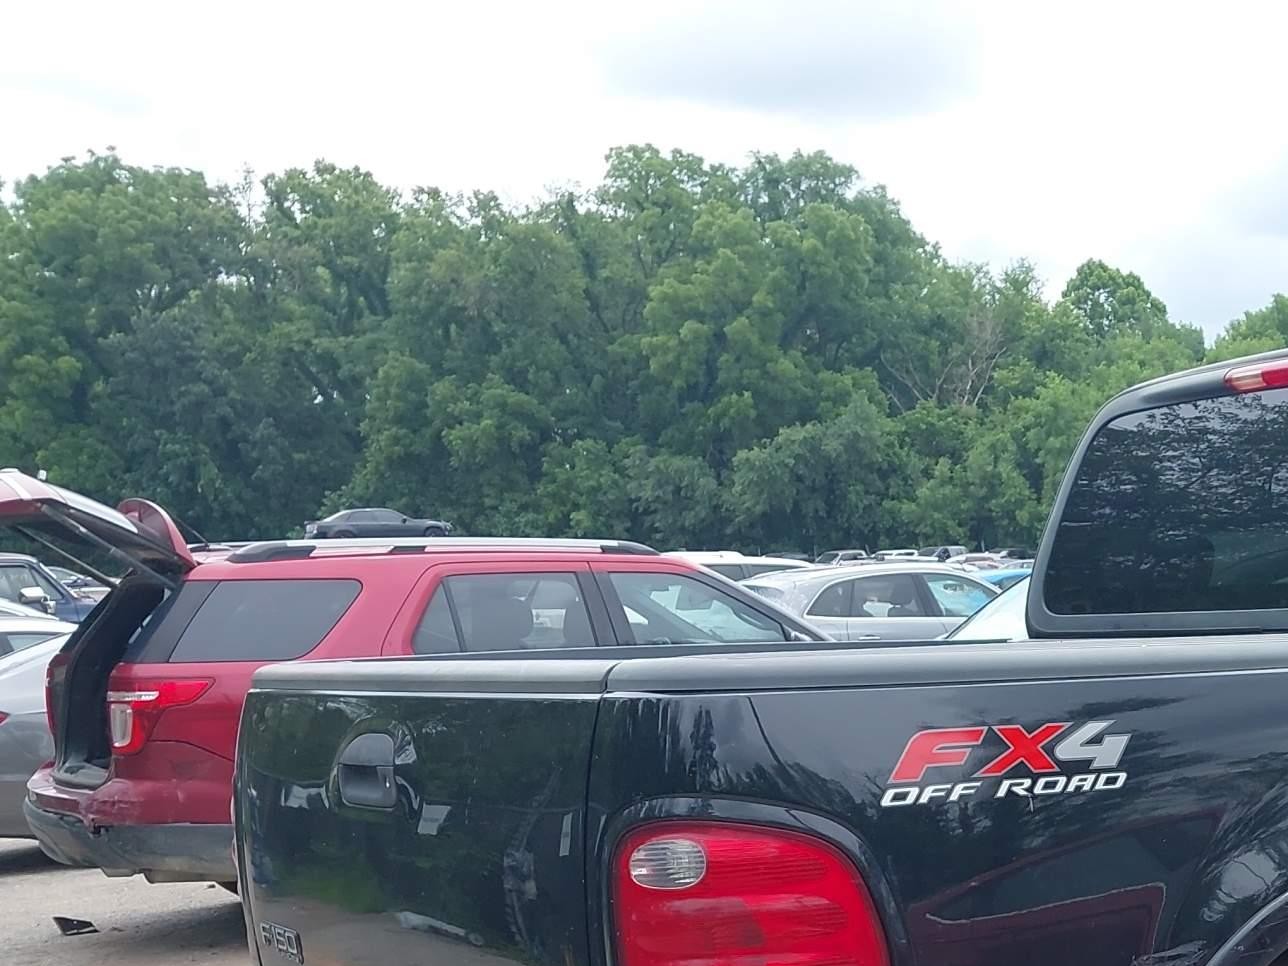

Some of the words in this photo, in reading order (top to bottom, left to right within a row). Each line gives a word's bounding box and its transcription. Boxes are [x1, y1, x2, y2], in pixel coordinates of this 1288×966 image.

[886, 719, 1132, 784] FX4
[879, 781, 984, 808] OFF
[994, 771, 1129, 799] ROAD
